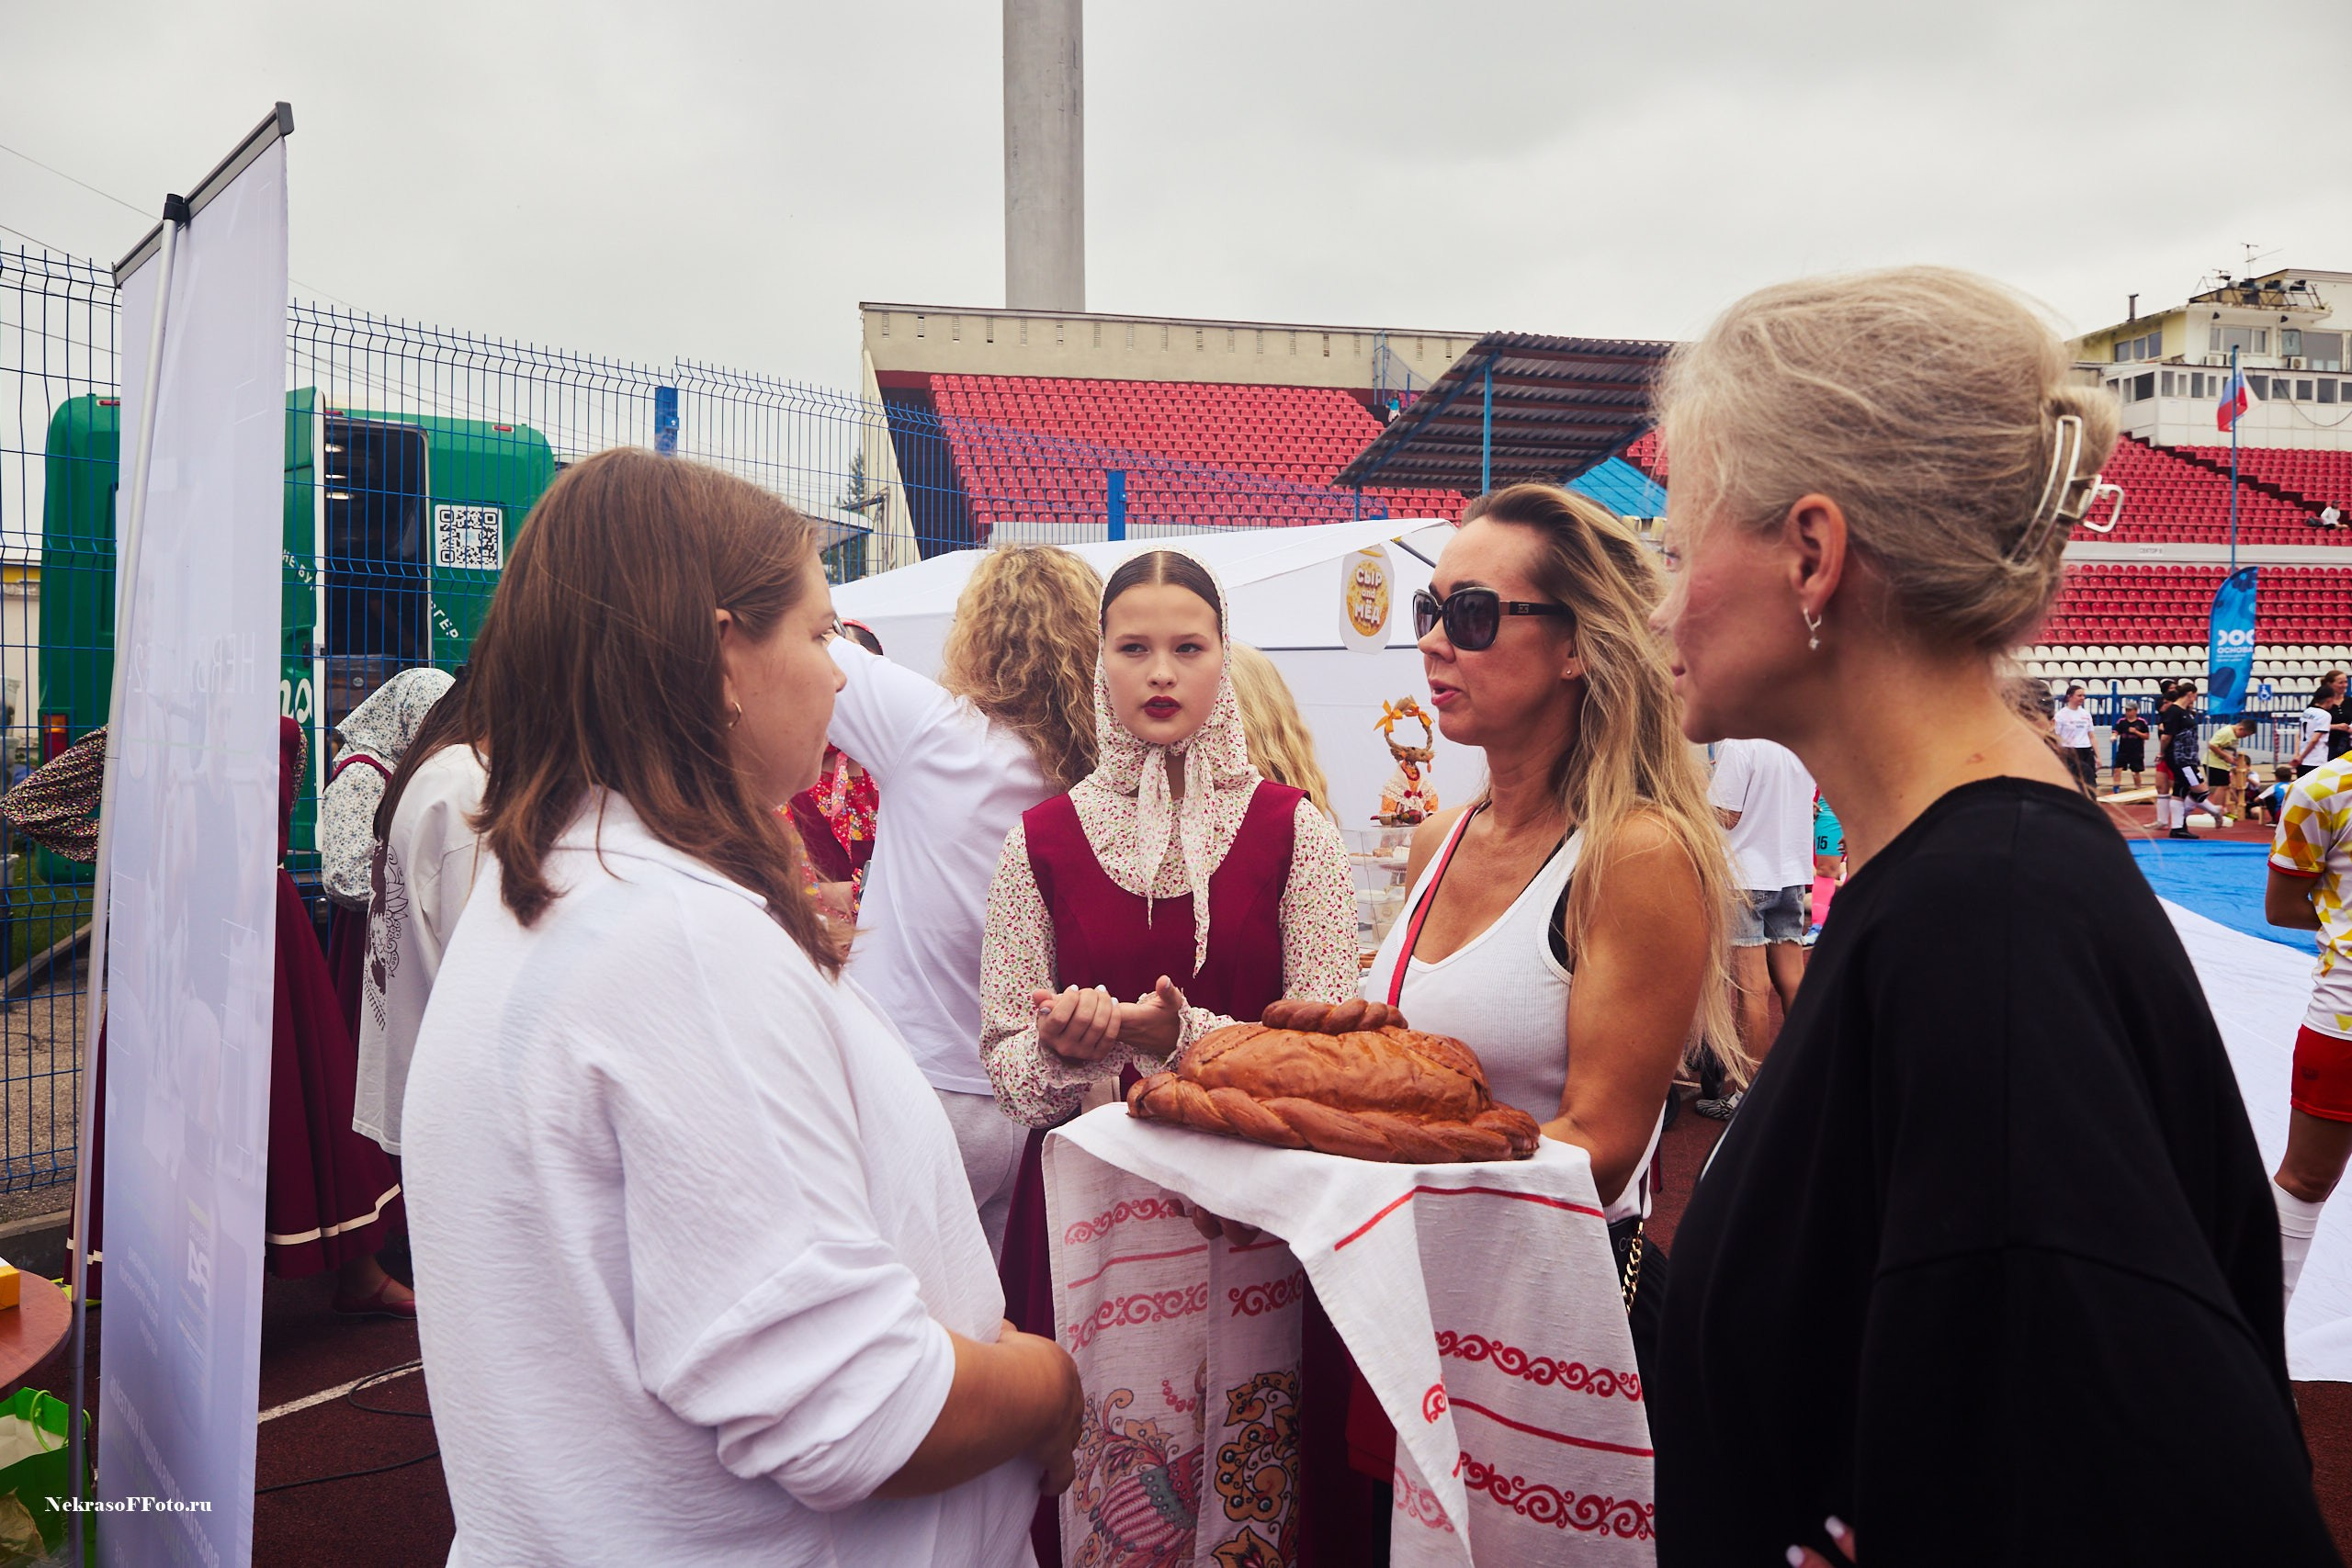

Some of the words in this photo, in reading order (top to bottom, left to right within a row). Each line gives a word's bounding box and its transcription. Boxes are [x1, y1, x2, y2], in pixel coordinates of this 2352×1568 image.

[1362, 588, 1375, 599] and
[1354, 600, 1382, 625] МЁД
[1817, 836, 1828, 850] 15
